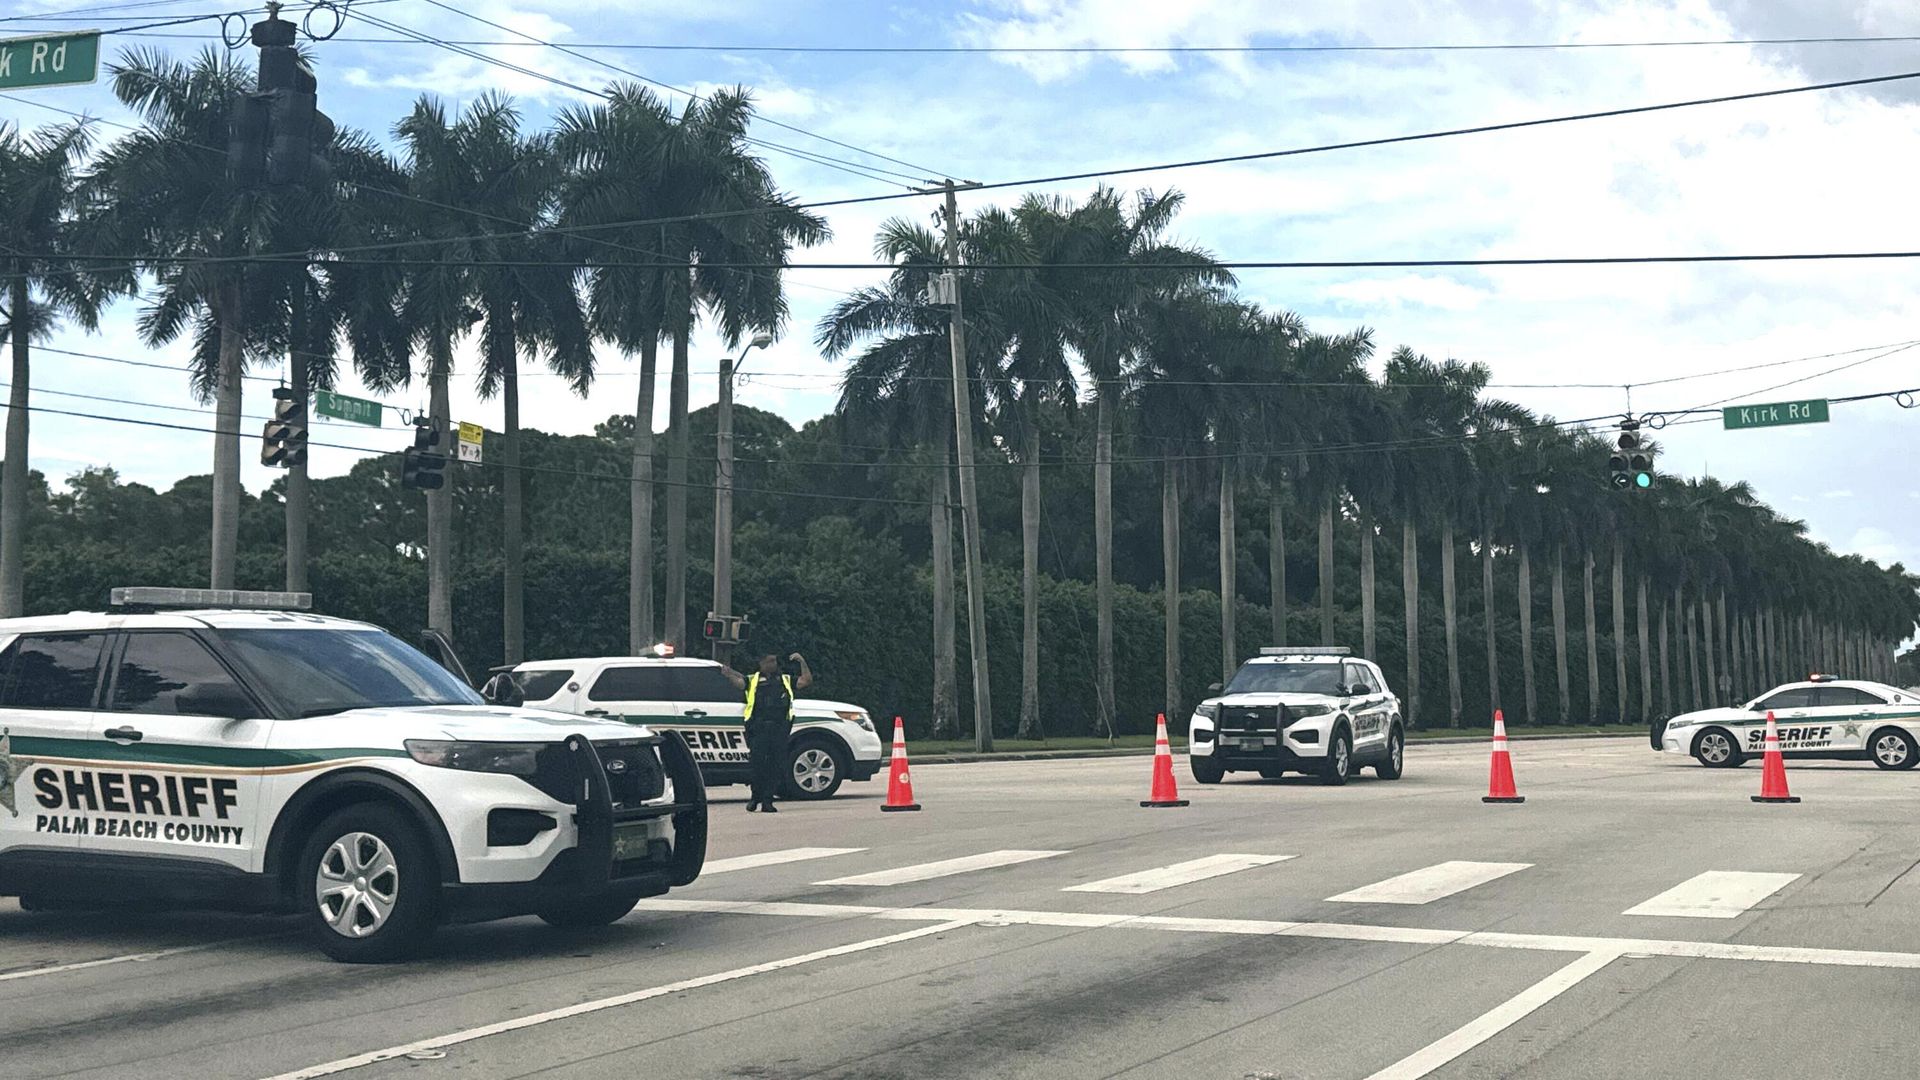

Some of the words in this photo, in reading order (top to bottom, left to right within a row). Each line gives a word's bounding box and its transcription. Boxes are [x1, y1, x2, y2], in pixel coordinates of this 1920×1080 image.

[30, 41, 67, 74] Rd
[1741, 407, 1778, 424] Kirk
[1789, 403, 1810, 419] Rd
[680, 731, 750, 749] ERIF
[1800, 740, 1832, 748] COUNTY
[694, 752, 716, 761] ACH
[719, 751, 750, 761] COUN
[33, 768, 238, 819] SHERIFF
[36, 815, 89, 834] PALM
[94, 817, 157, 839] BEACH
[163, 822, 243, 845] COUNTY
